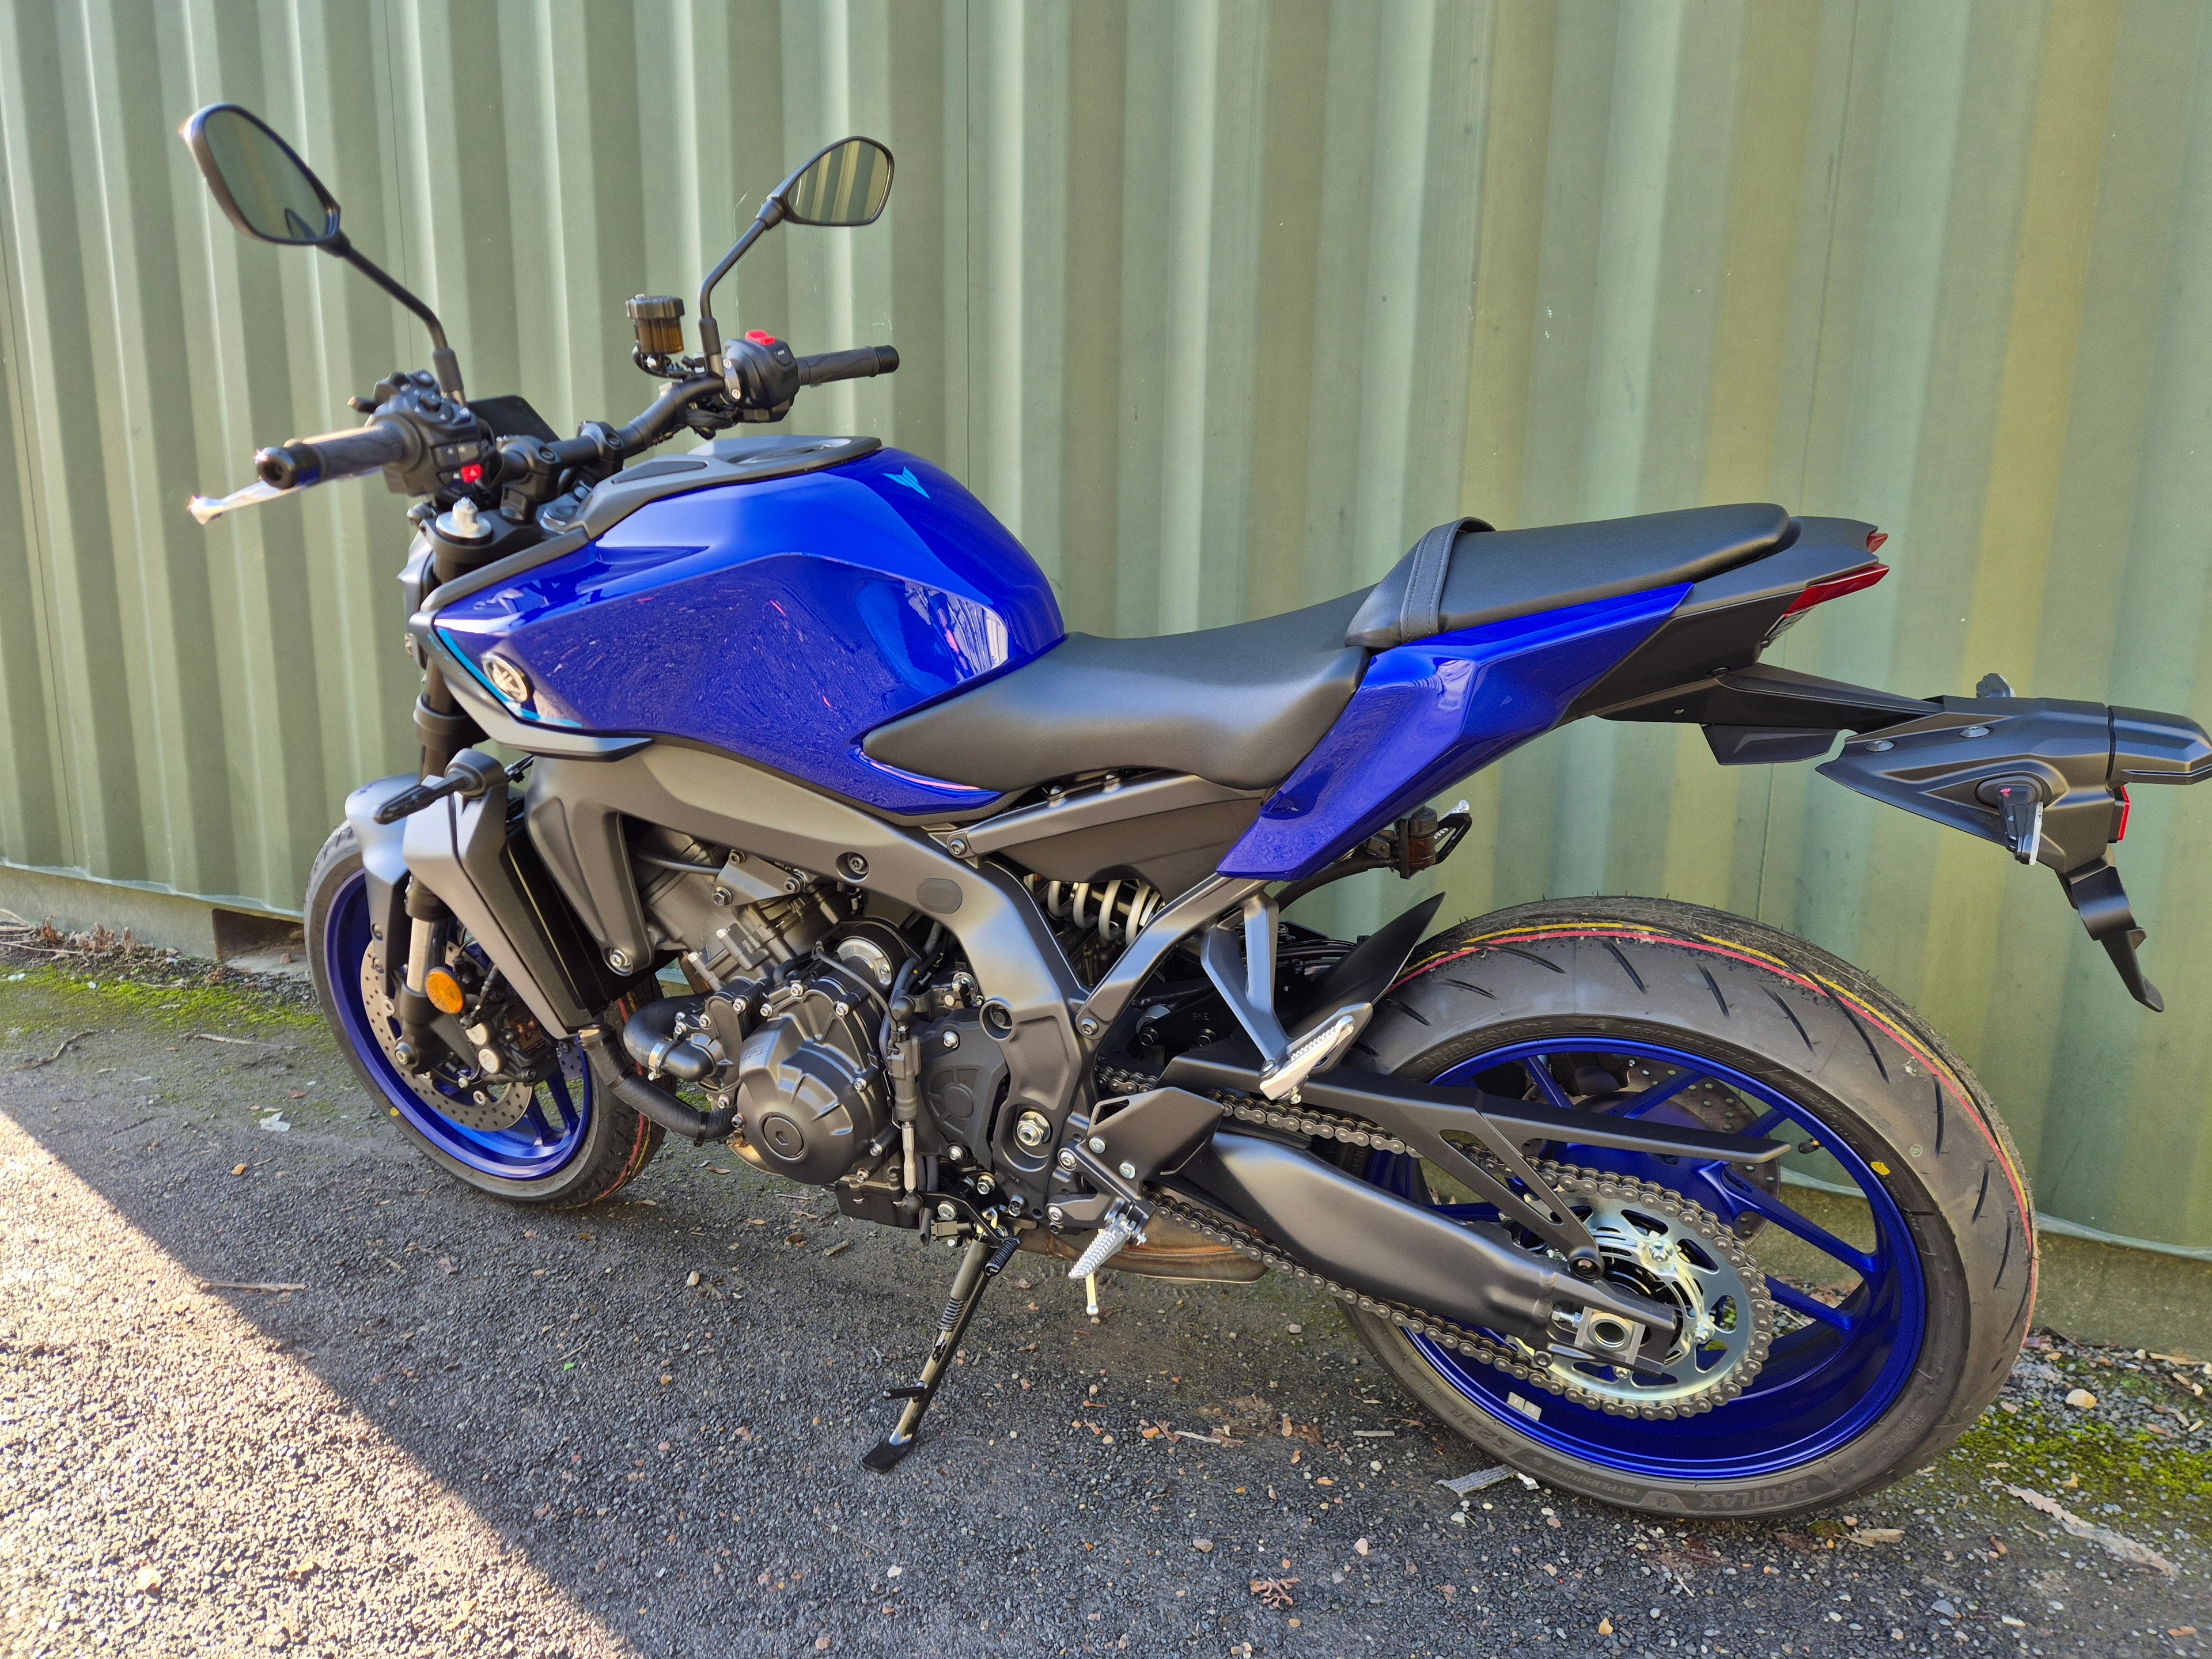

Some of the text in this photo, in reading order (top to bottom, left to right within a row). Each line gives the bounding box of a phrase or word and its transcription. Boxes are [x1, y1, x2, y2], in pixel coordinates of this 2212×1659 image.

[1416, 1022, 1551, 1070] BRIDGESTONE
[1546, 1464, 1637, 1497] HYPERSPORT
[1699, 1480, 1810, 1508] BATTLAX
